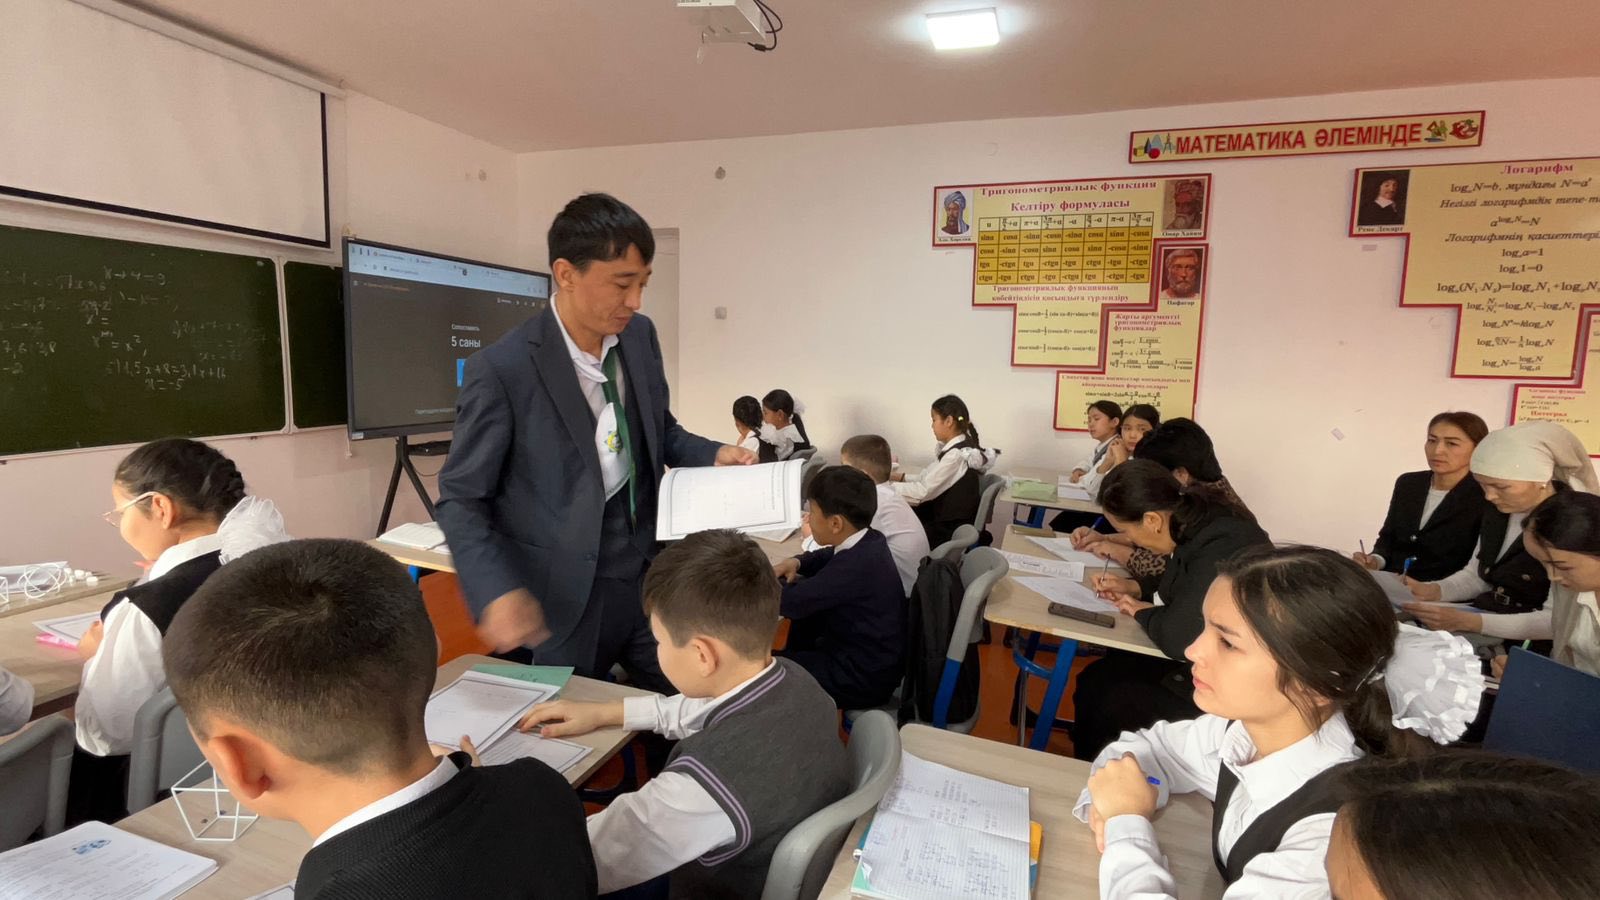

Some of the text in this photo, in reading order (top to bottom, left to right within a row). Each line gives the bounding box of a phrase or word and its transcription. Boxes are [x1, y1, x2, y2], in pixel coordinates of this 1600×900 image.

[1176, 123, 1422, 154] МАТЕМАТИКА ӘЛЕМІНДЕ
[1500, 163, 1574, 175] Логарифм
[1011, 200, 1130, 212] Келтіру формуласы
[452, 336, 480, 348] 5 саны
